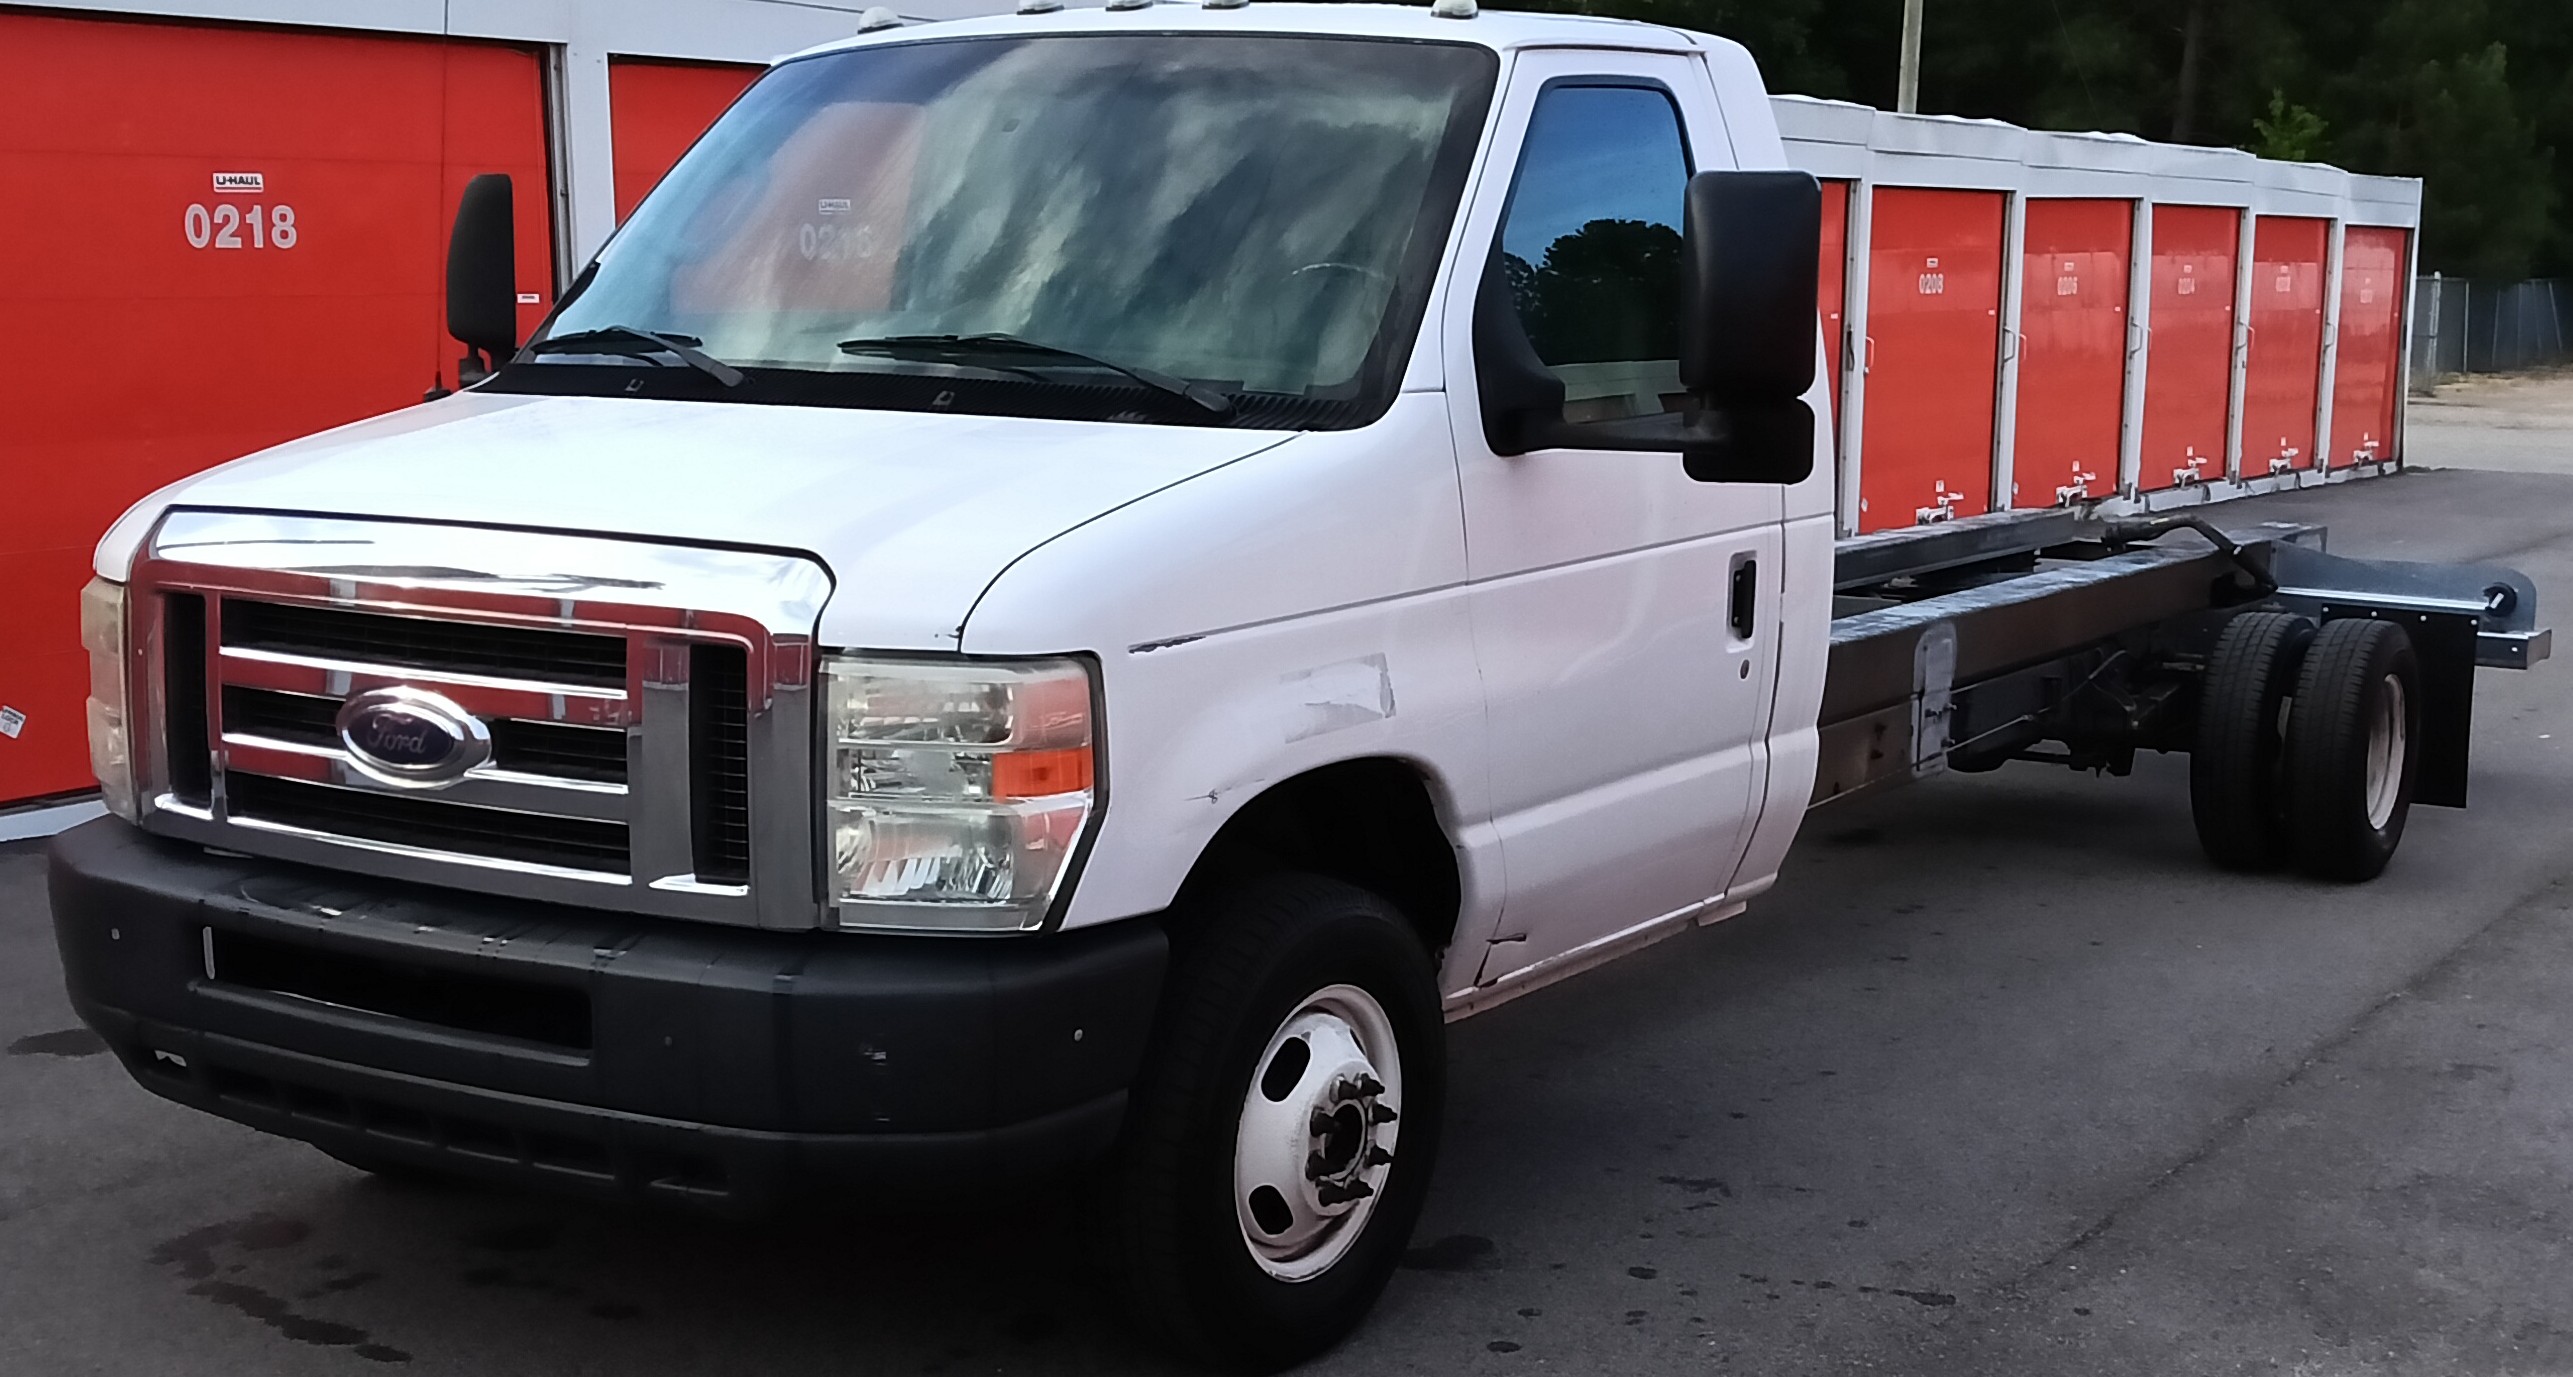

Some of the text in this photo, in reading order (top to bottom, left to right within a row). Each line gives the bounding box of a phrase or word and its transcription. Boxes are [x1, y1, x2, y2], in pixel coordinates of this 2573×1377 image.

[215, 176, 261, 186] U-HAUL
[184, 203, 298, 250] 0218
[366, 712, 428, 755] Ford
